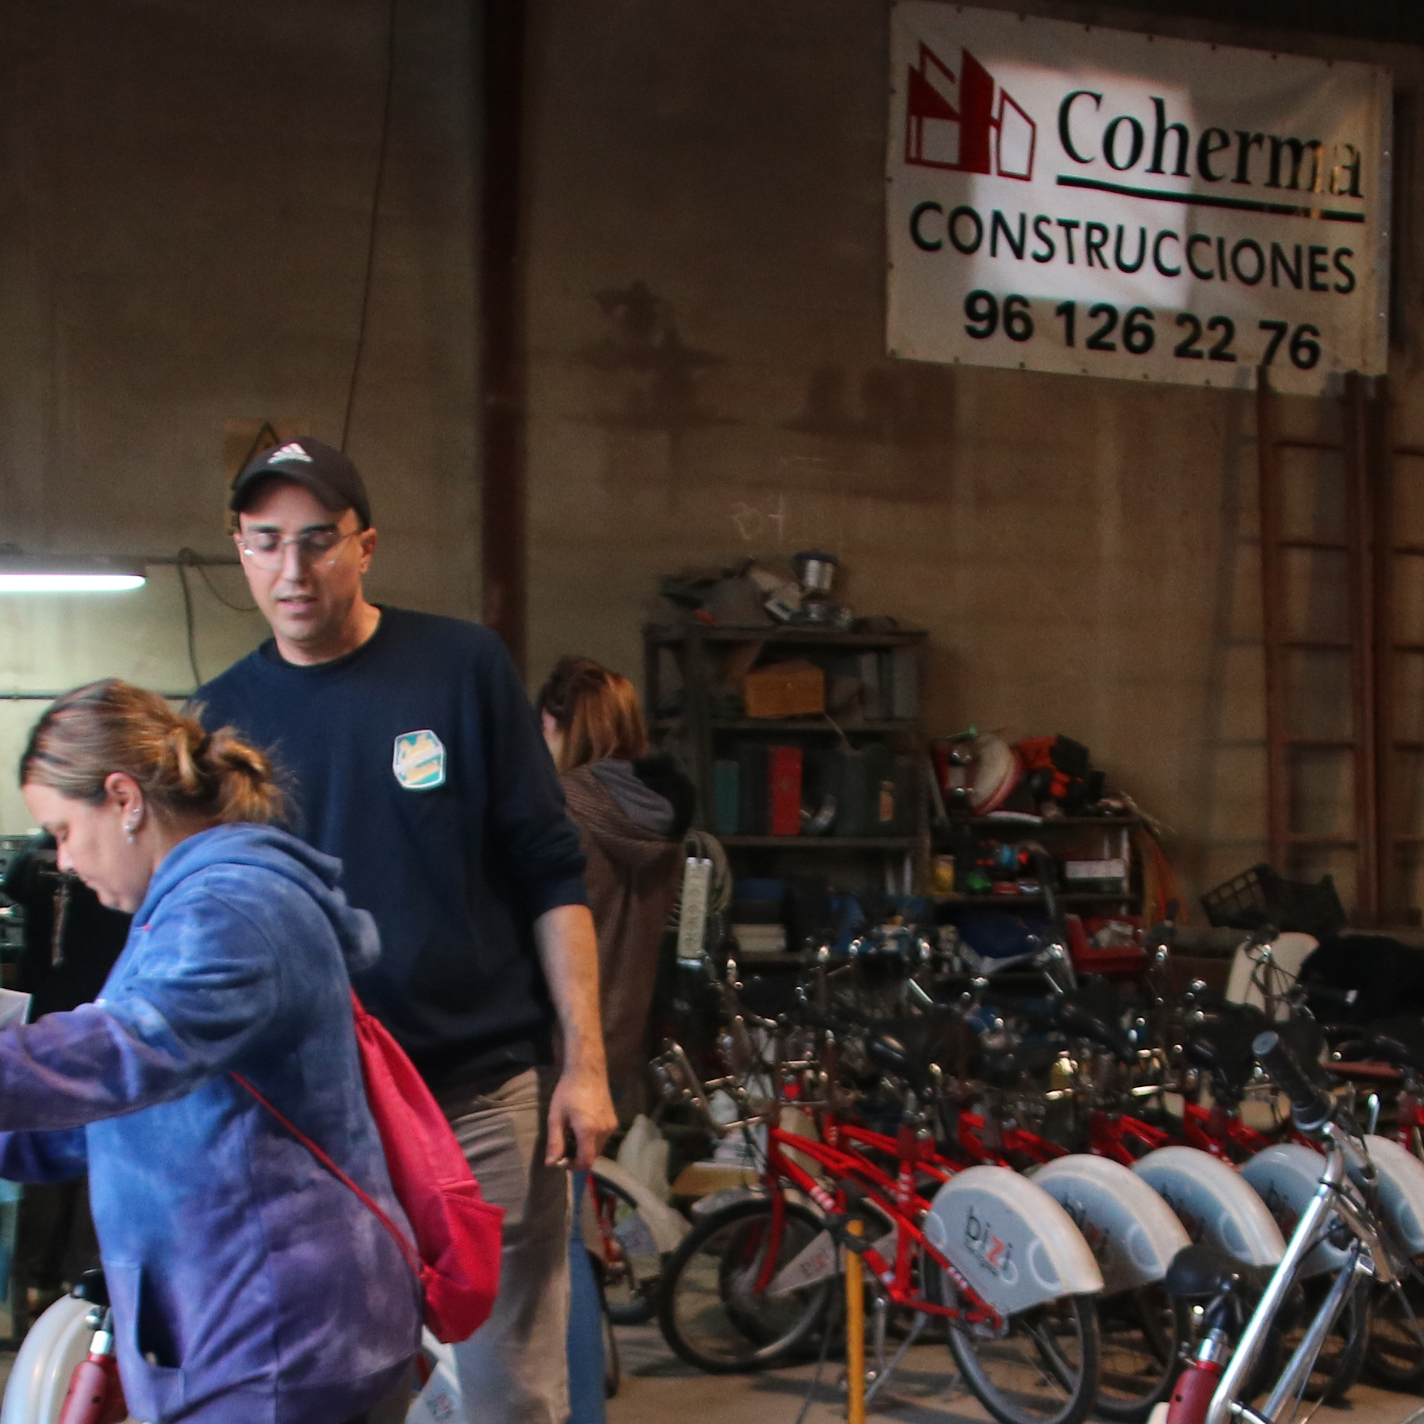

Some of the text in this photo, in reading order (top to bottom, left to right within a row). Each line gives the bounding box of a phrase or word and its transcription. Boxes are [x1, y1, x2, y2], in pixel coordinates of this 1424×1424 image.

[1057, 89, 1364, 198] Coherma
[909, 201, 1356, 294] CONSTRUCCIONES
[964, 290, 1323, 370] 96 126 22 76
